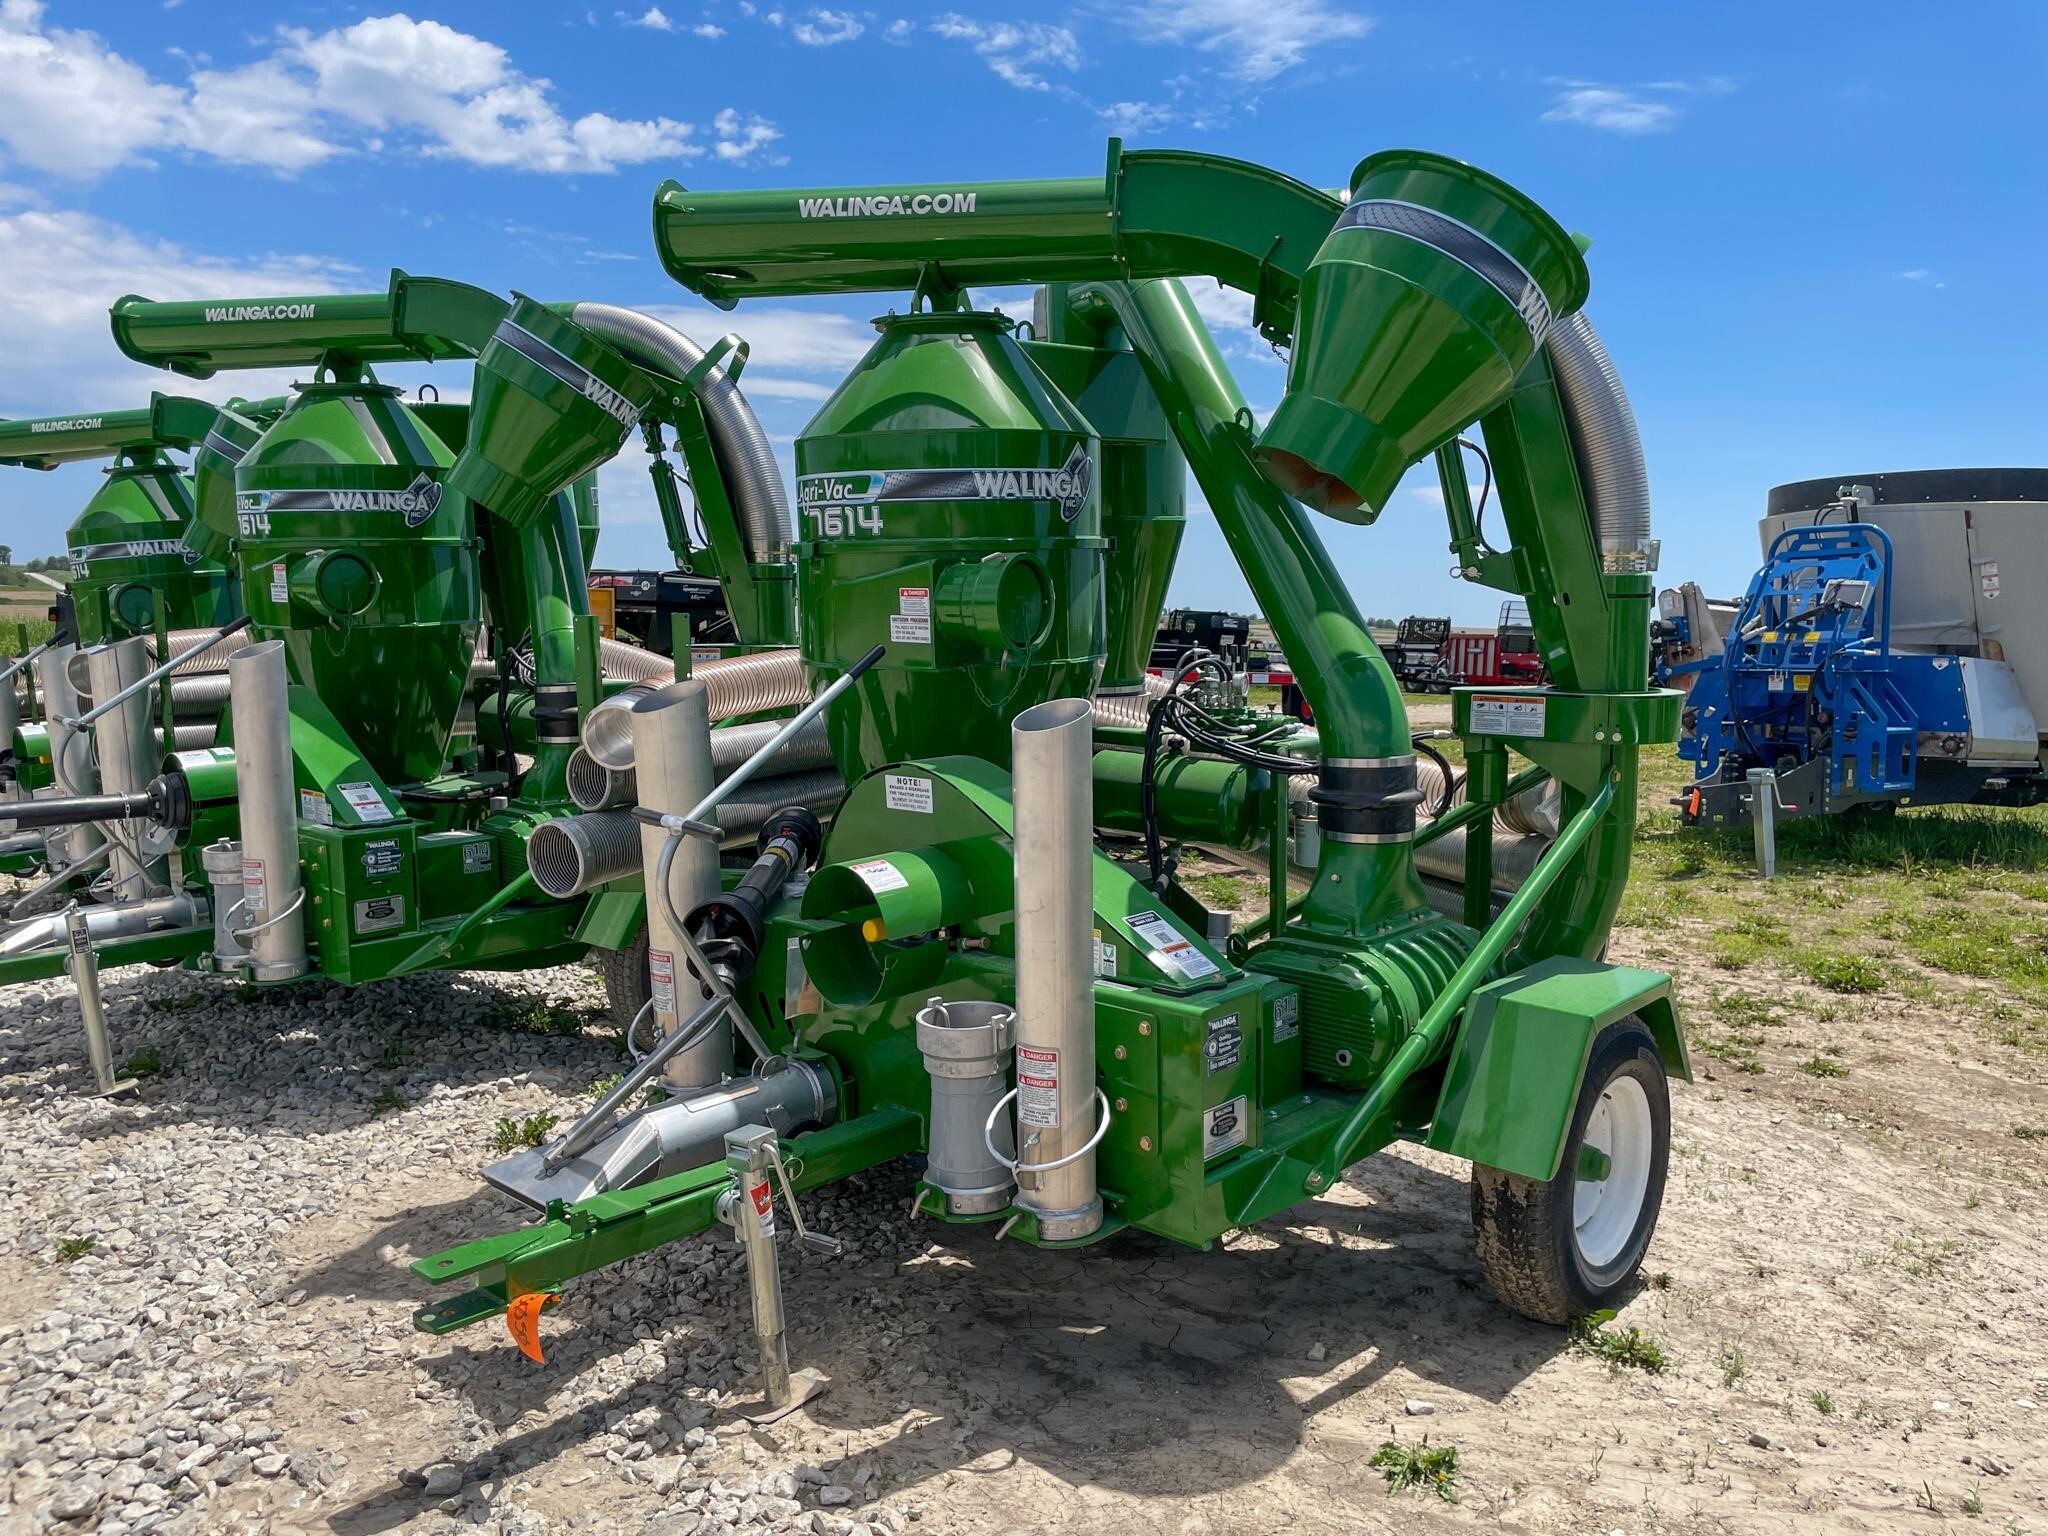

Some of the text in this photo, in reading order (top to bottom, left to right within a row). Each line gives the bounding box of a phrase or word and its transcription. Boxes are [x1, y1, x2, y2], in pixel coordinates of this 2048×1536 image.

[972, 469, 1085, 499] WALINGA
[329, 491, 429, 512] WALINGA
[808, 505, 884, 537] 7614
[897, 777, 921, 786] NOTE!
[1025, 1051, 1053, 1061] DANGER
[1025, 1077, 1054, 1088] DANGER
